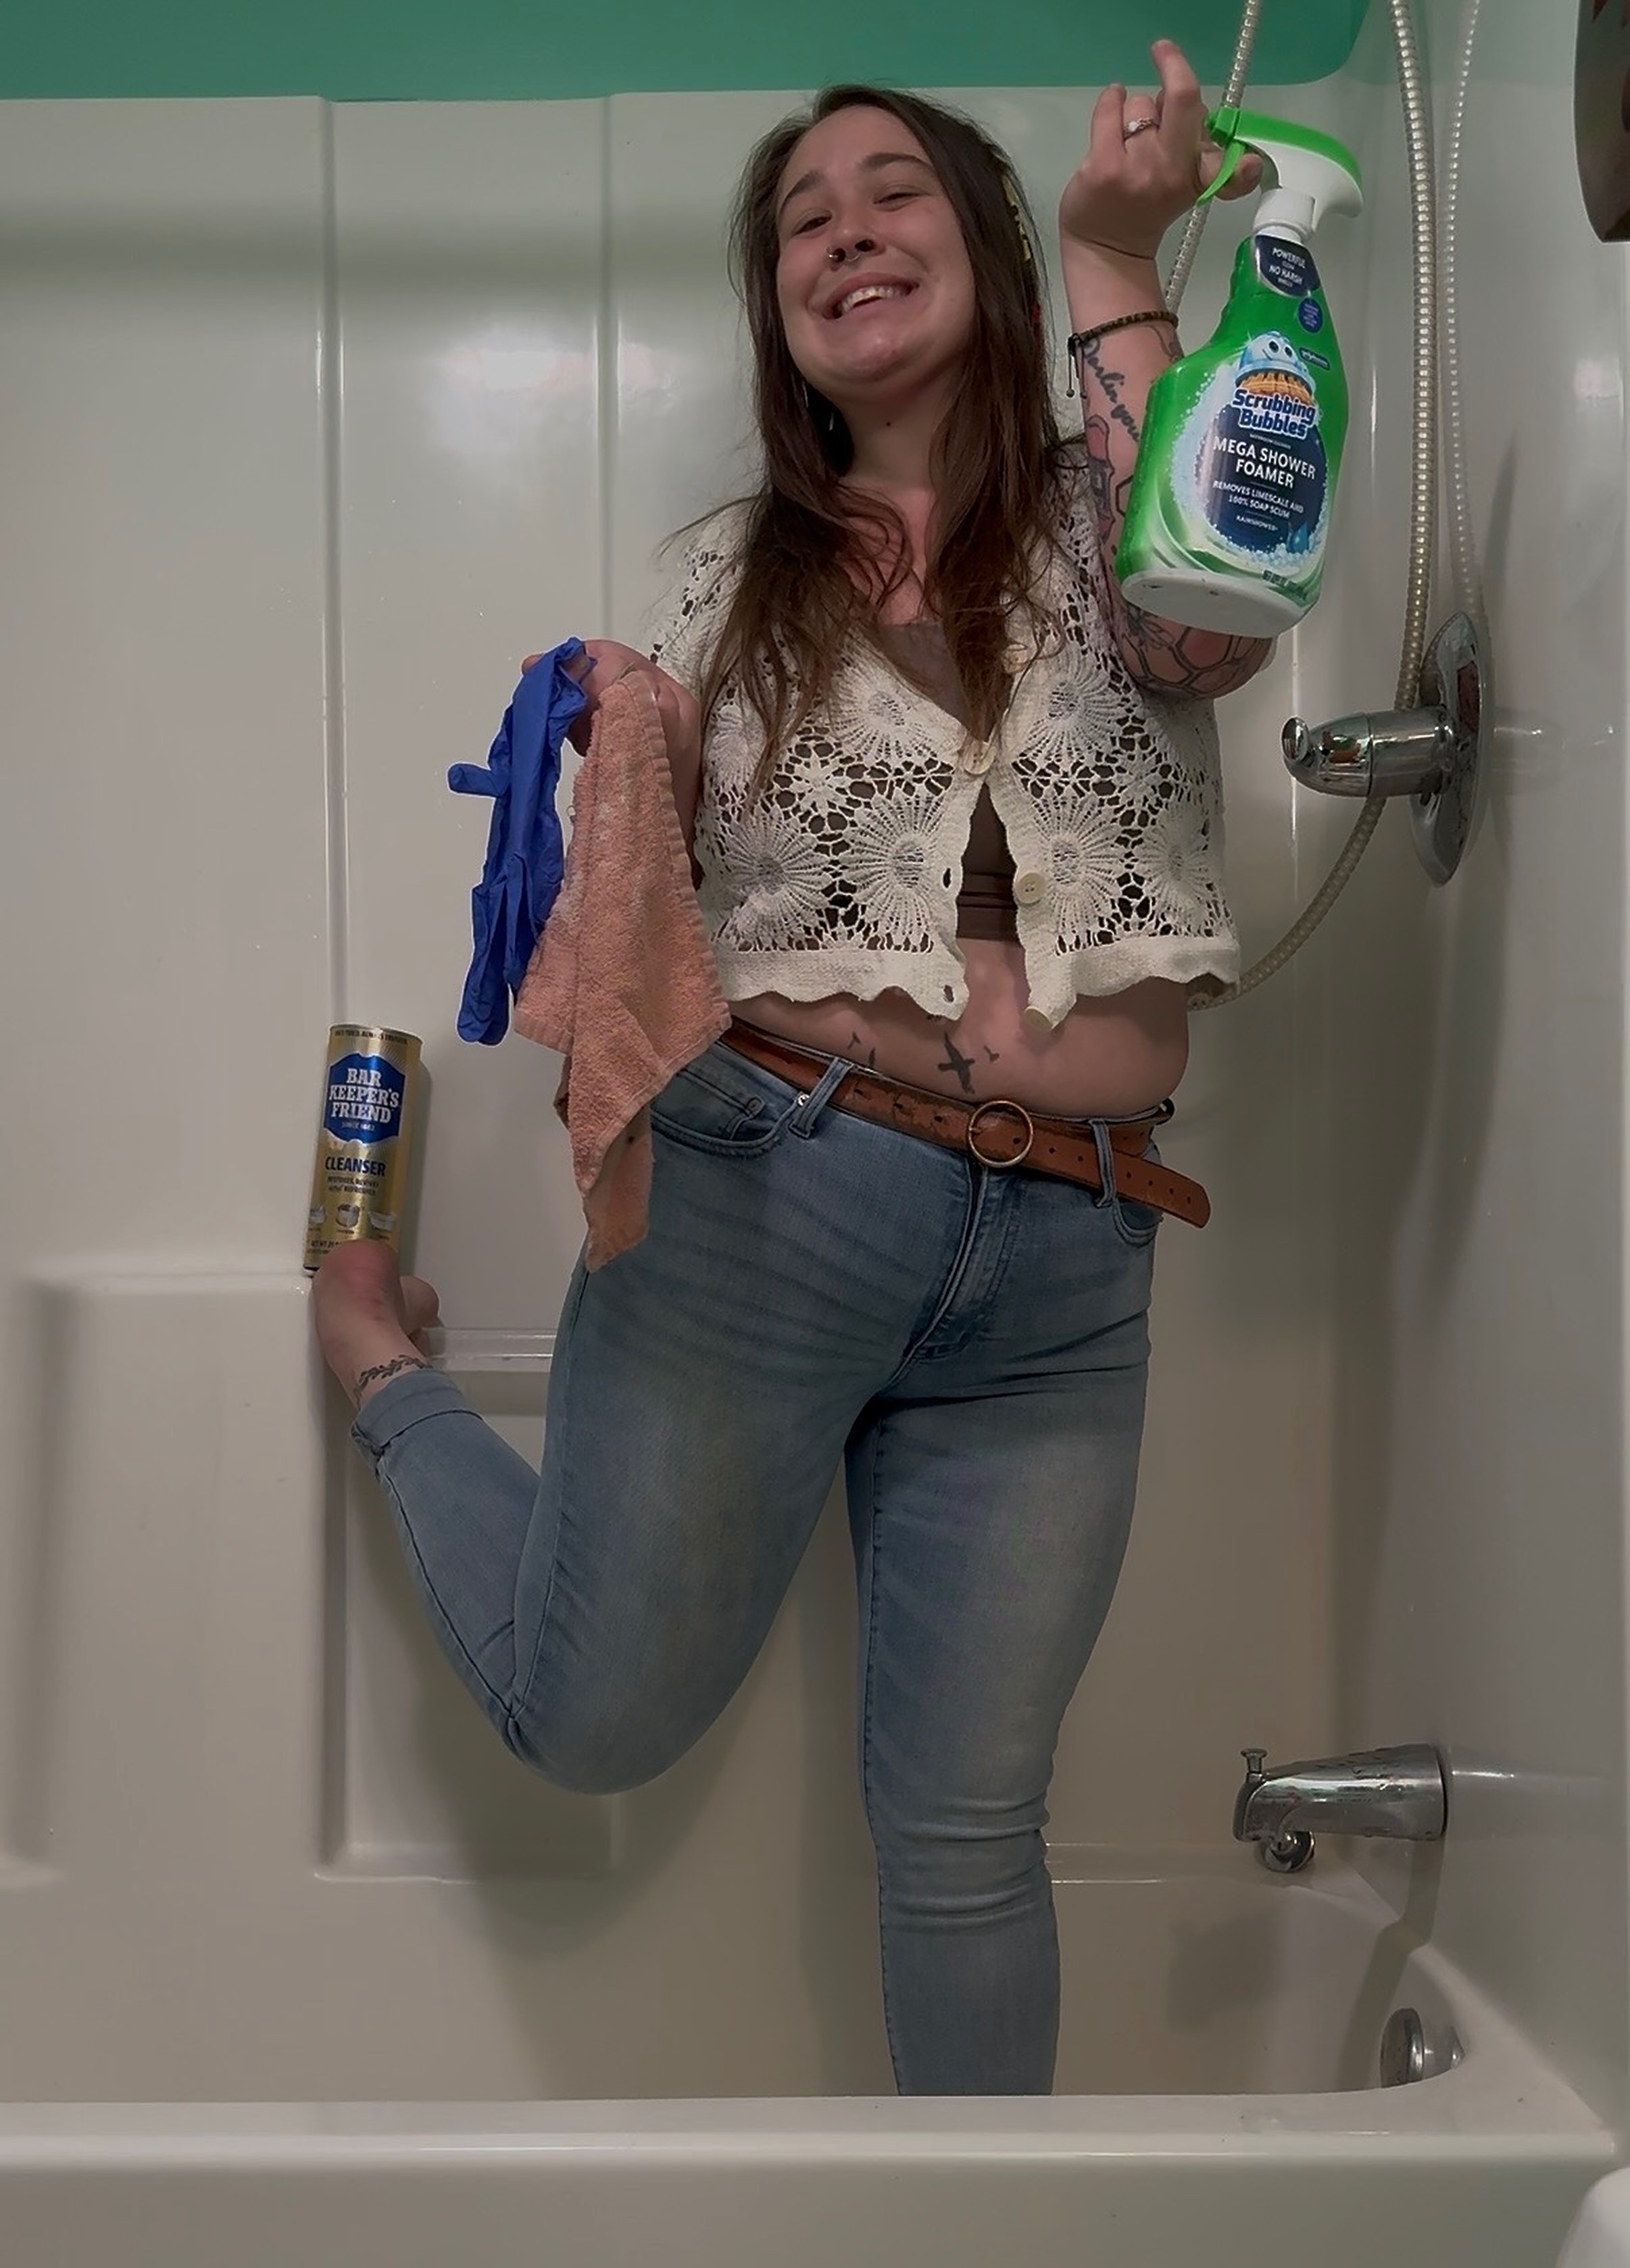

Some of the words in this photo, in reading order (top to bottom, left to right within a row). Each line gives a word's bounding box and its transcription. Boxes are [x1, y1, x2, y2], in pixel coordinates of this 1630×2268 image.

[1268, 264, 1281, 275] NO
[1232, 389, 1316, 426] Scrubbing
[1239, 408, 1307, 437] Bubbles
[1214, 436, 1256, 459] MEGA
[1260, 447, 1316, 479] SHOWER
[1235, 459, 1294, 488] FOAMER
[1212, 480, 1250, 495] REMOVES
[1252, 488, 1289, 508] LIMESCALE
[1290, 501, 1304, 514] AND
[1228, 494, 1248, 506] 100%
[1250, 499, 1269, 512] SOAP
[1270, 506, 1290, 519] SCUM
[346, 1068, 382, 1087] BAR
[328, 1084, 400, 1108] KEEPER'S
[330, 1102, 392, 1124] FRIEND
[325, 1156, 387, 1177] CLEANSER
